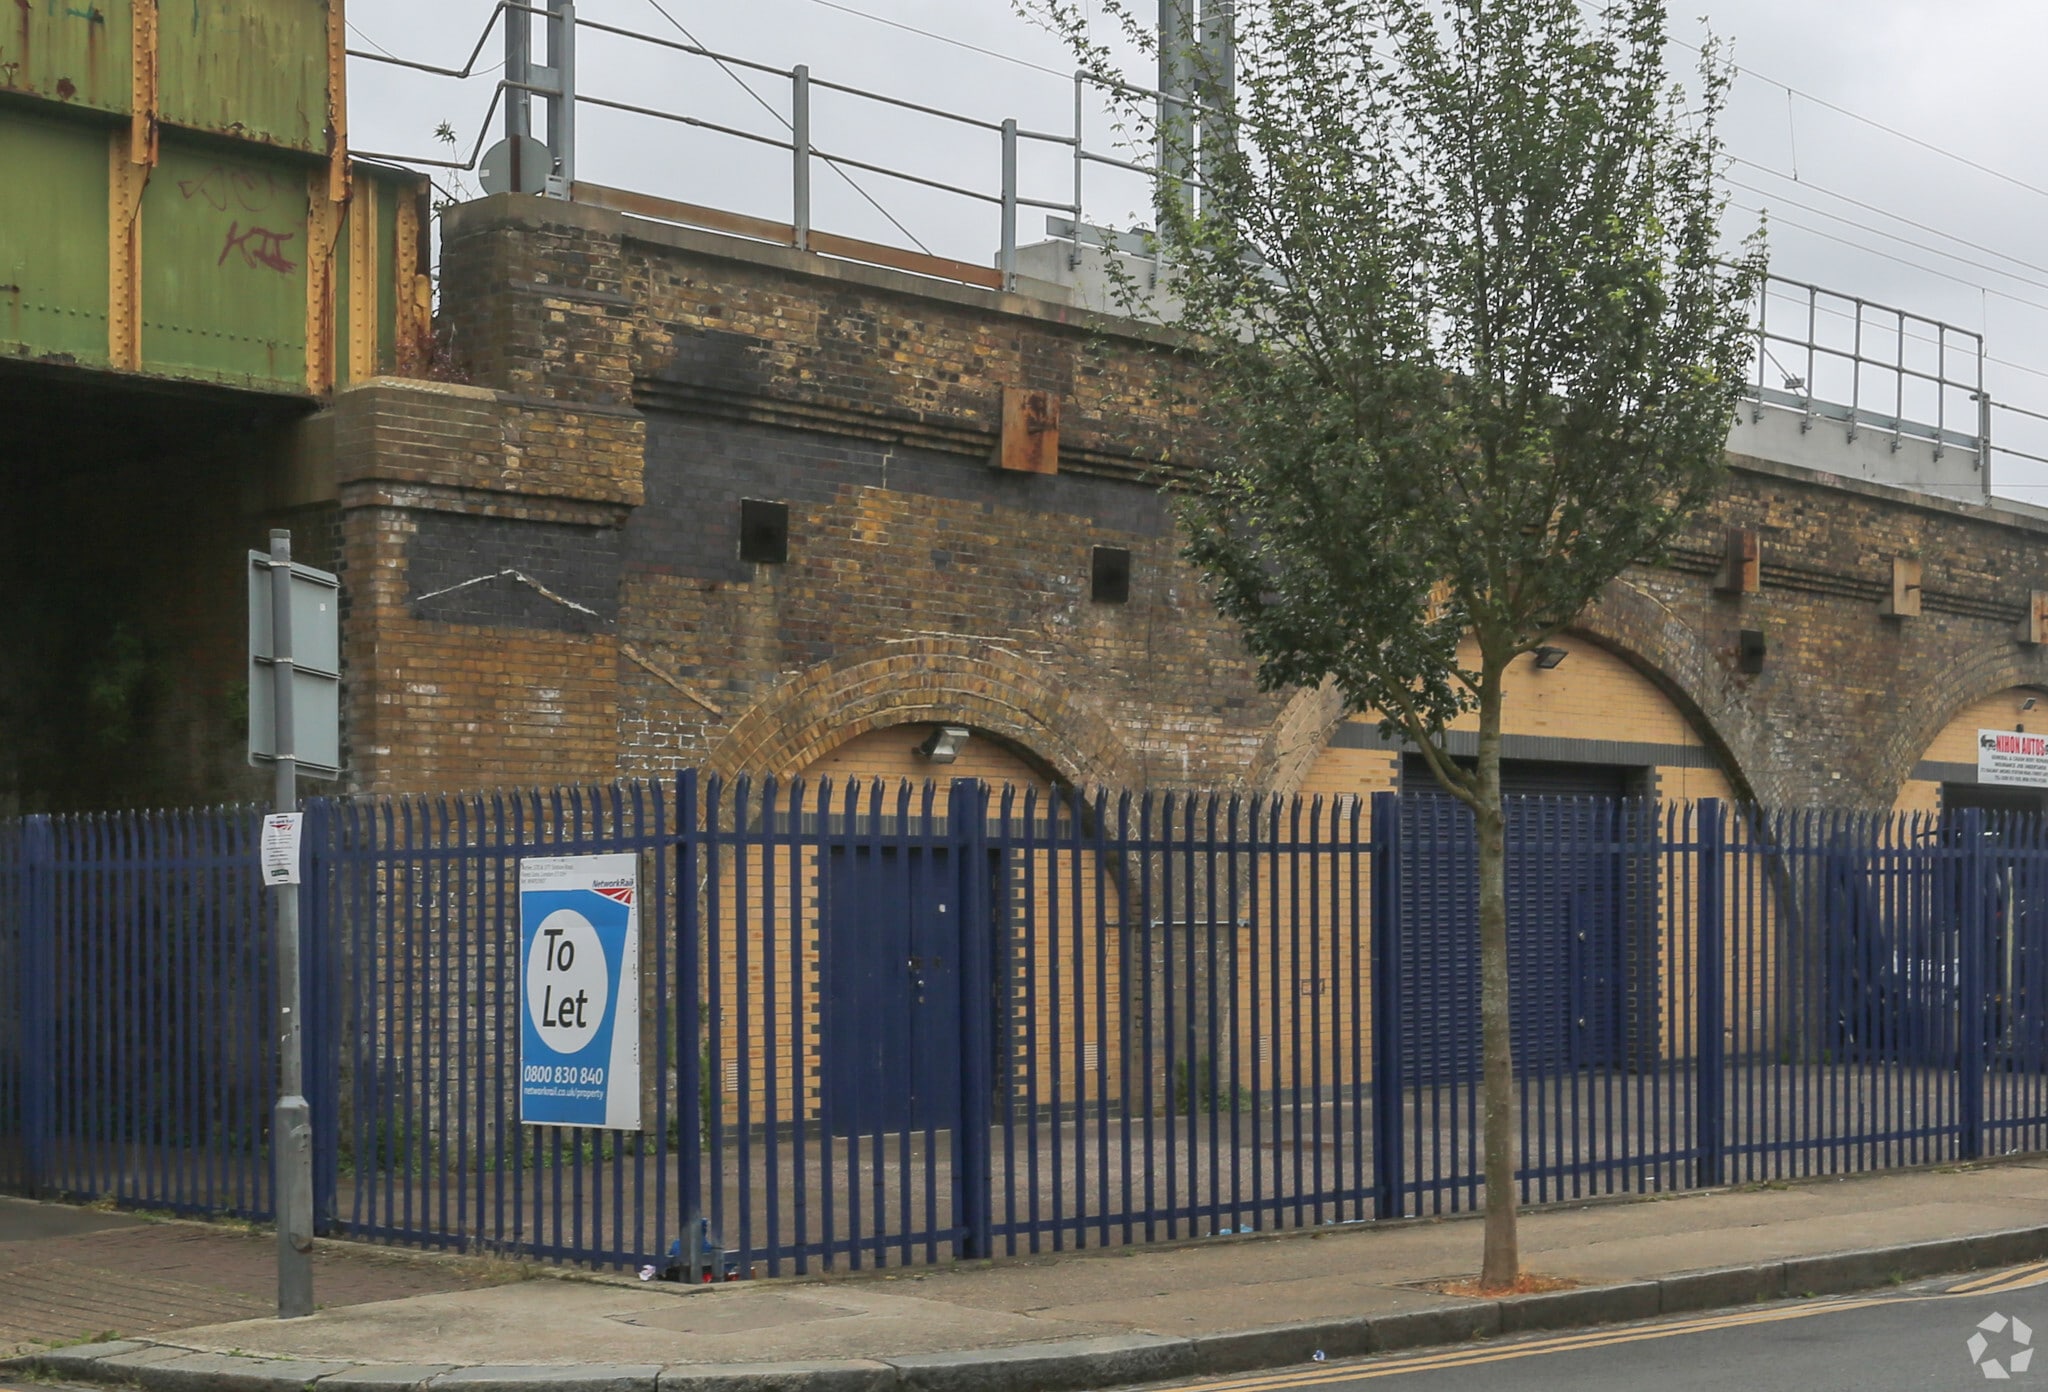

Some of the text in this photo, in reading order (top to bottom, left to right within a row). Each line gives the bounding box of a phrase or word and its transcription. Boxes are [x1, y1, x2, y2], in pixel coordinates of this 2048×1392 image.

[1996, 735, 2045, 756] NIHON AUTOS
[543, 928, 575, 972] To
[542, 985, 588, 1028] Let
[524, 1065, 604, 1085] 0800 830 840
[523, 1086, 604, 1101] networkrail.co.uk/property
